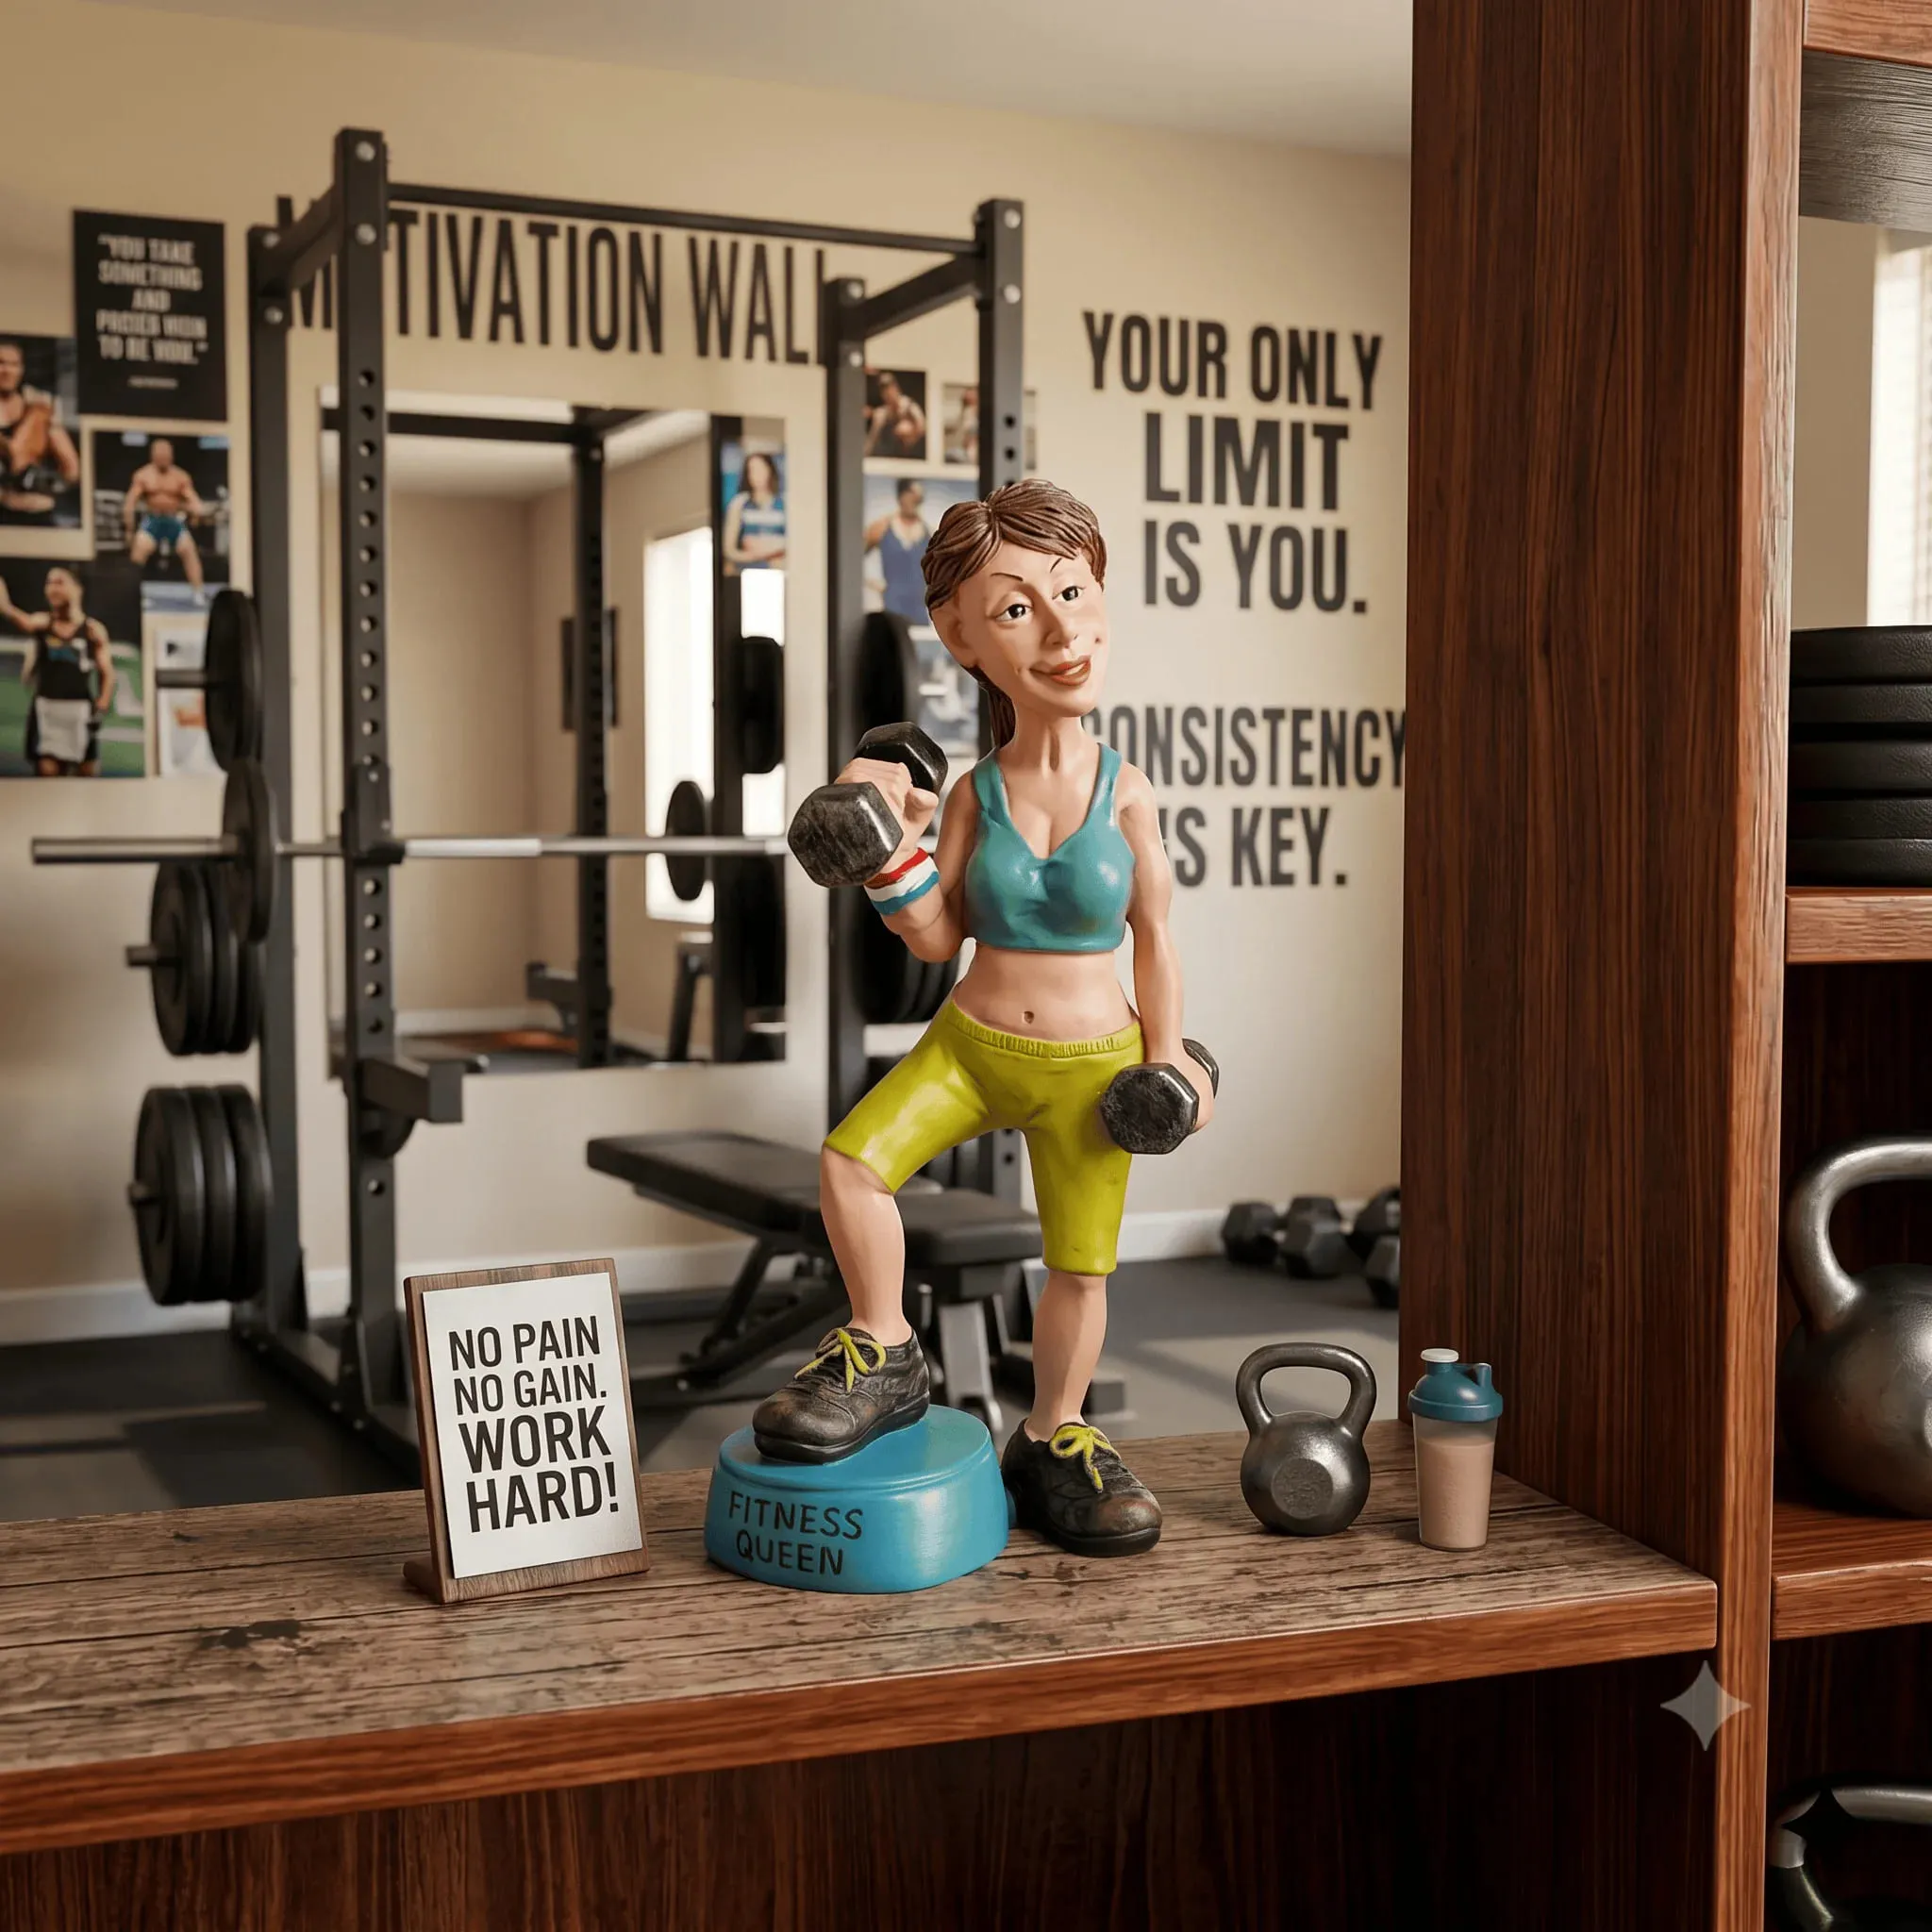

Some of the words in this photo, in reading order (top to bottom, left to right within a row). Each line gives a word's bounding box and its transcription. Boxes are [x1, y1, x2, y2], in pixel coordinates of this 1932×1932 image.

[1083, 311, 1227, 399] YOUR
[1251, 325, 1383, 410] ONLY
[1144, 411, 1350, 510] LIMIT
[1144, 520, 1201, 607] IS
[1227, 524, 1367, 613] YOU.
[1231, 807, 1347, 887] KEY.
[448, 1326, 503, 1371] NO
[513, 1315, 601, 1364] PAIN
[454, 1374, 504, 1415] NO
[513, 1362, 608, 1407] GAIN.
[458, 1405, 612, 1474] WORK
[466, 1461, 619, 1533] HARD!
[728, 1491, 863, 1540] FITNESS
[736, 1529, 843, 1575] QUEEN
